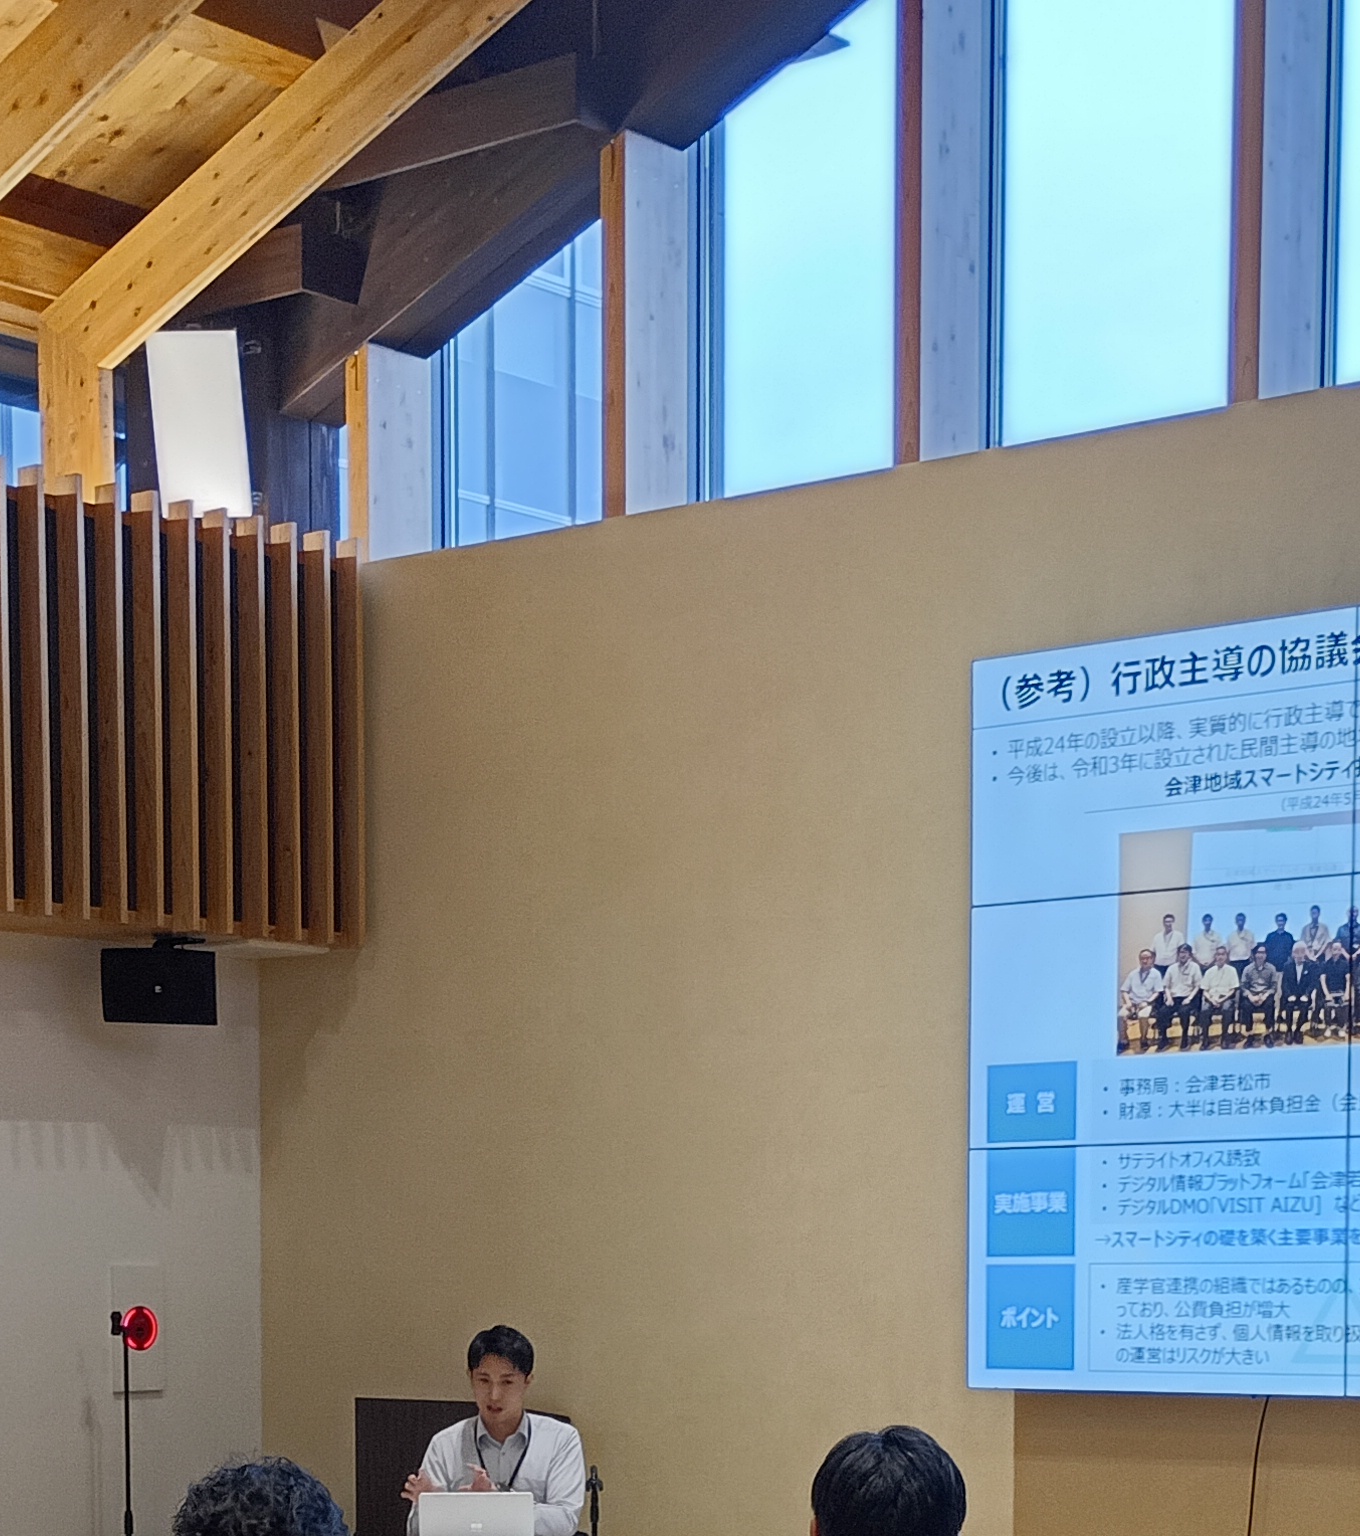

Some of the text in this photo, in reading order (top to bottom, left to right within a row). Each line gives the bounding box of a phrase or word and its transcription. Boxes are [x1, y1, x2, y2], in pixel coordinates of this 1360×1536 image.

[1118, 1149, 1261, 1171] サテライトオフィス誘致
[994, 1191, 1068, 1214] 実施事業
[1000, 1306, 1059, 1329] ポイント
[1115, 1347, 1270, 1366] の運営はリスクが大きい
